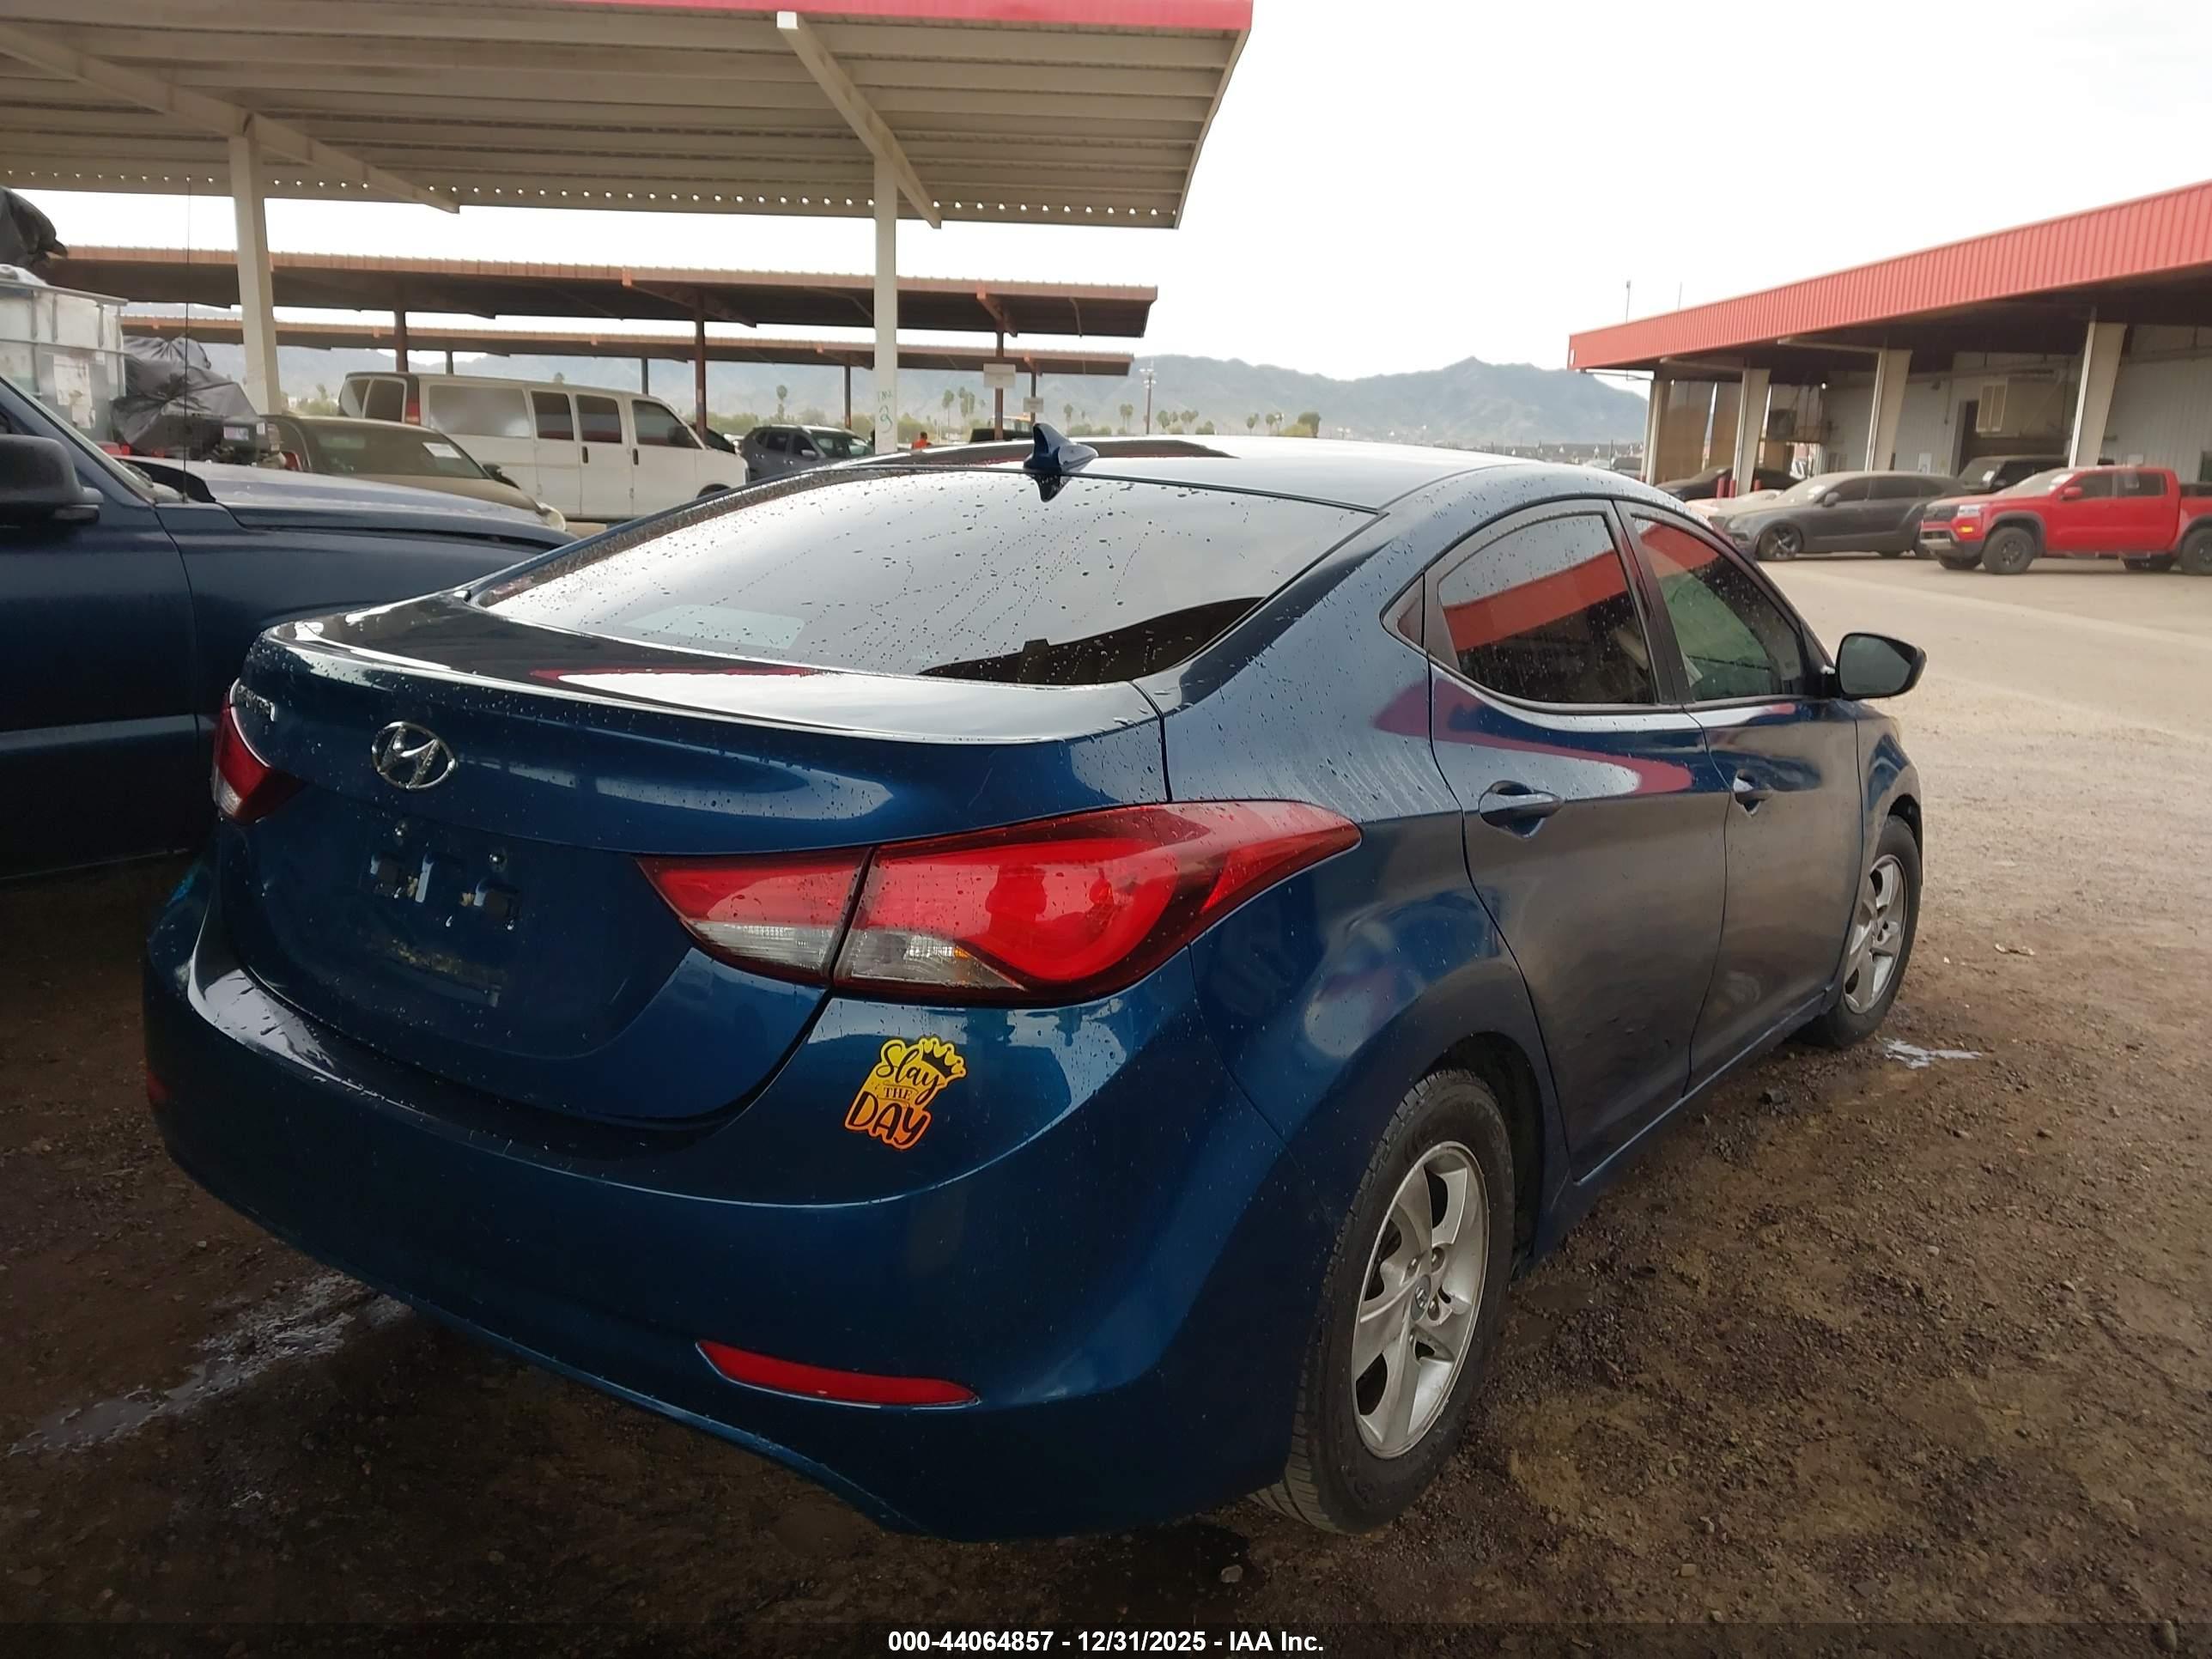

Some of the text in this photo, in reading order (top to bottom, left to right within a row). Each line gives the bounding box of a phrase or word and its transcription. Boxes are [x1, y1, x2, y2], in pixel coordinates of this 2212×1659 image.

[875, 1042, 941, 1105] Slay
[884, 1086, 913, 1101] THE
[848, 1091, 928, 1146] DAY
